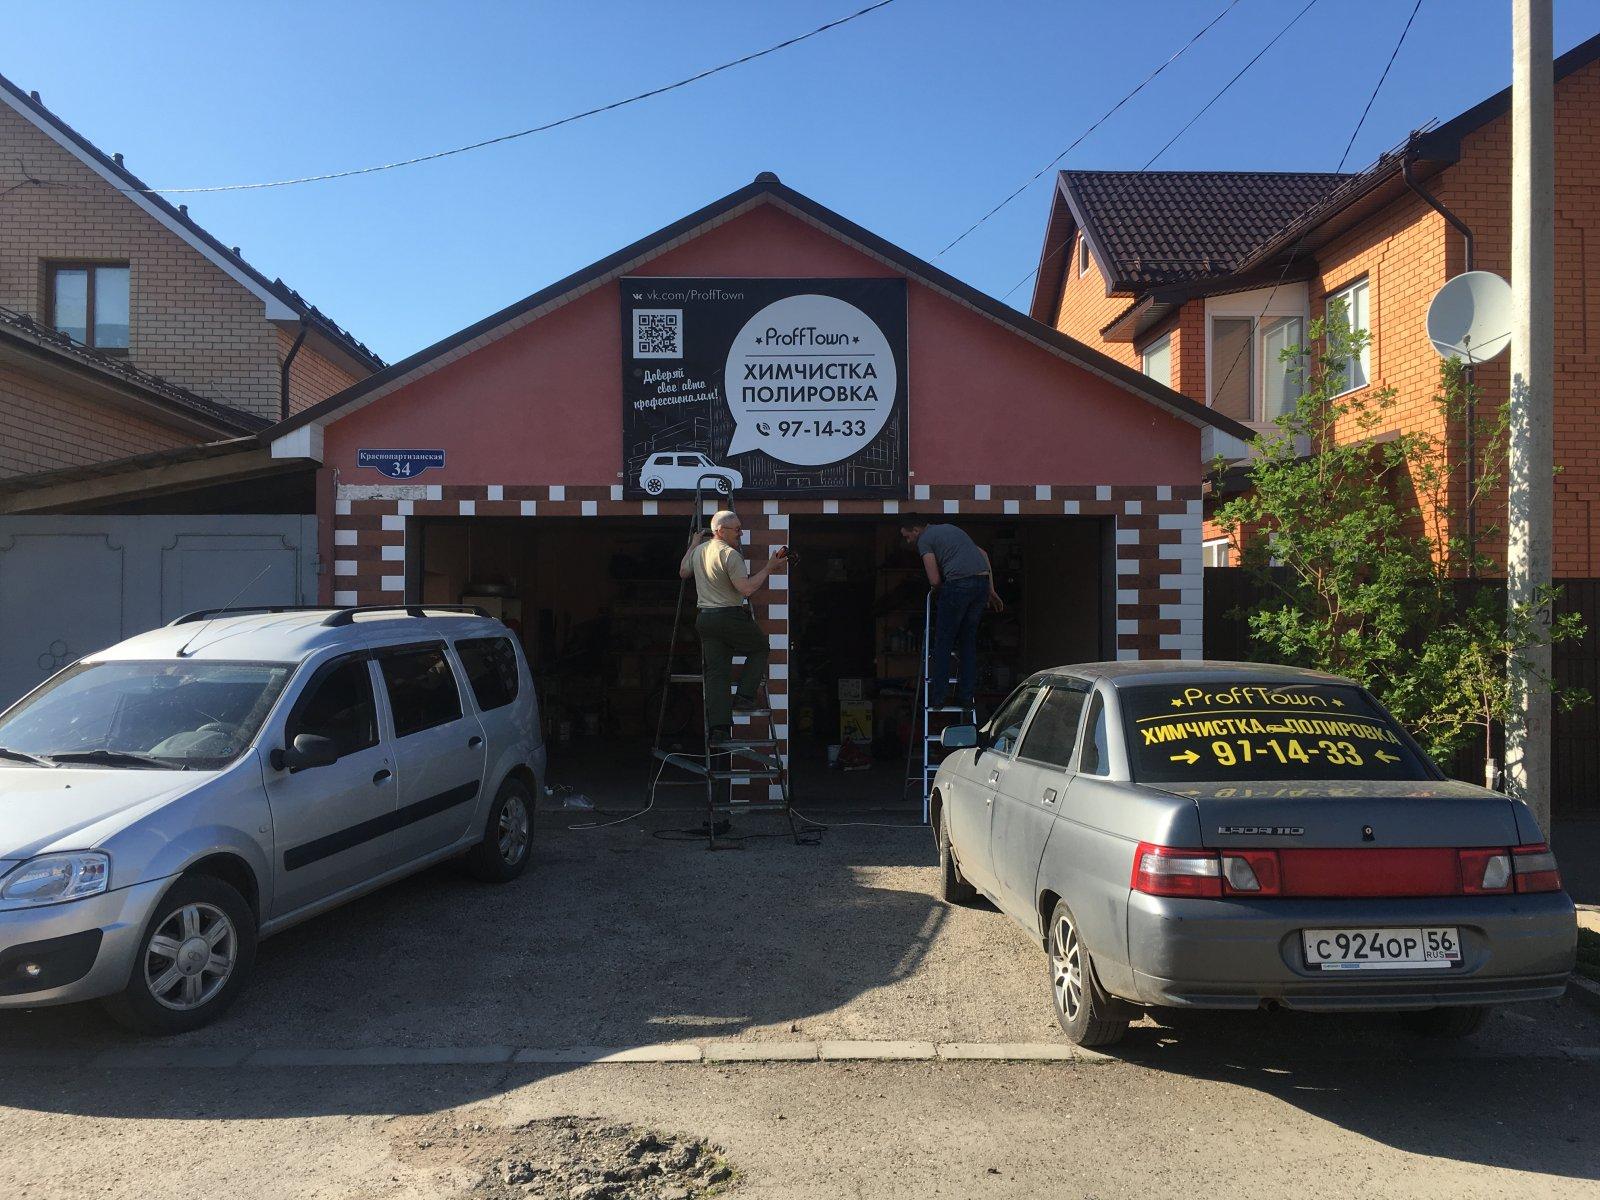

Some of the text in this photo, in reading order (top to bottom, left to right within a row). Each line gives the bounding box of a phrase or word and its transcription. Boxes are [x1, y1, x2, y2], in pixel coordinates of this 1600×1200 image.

[646, 289, 744, 303] vk.com/ProffTown
[765, 327, 849, 346] ProffTown
[643, 367, 685, 385] Доверяй
[743, 362, 878, 380] ХИМЧИСТКА
[657, 378, 707, 394] свое авто
[742, 385, 879, 403] ПОЛИРОВКА
[633, 388, 719, 411] профессионалам!
[778, 420, 867, 438] 97-14-33
[360, 452, 443, 461] Краснопартизанская
[391, 461, 411, 476] 34
[1184, 686, 1327, 707] ProffTown
[1140, 718, 1402, 746] ХИМЧИСТКА ПОЛИРОВКА
[1211, 739, 1364, 767] 97-14-33
[1316, 931, 1453, 960] С924ОР 56
[1426, 951, 1445, 959] RUS
